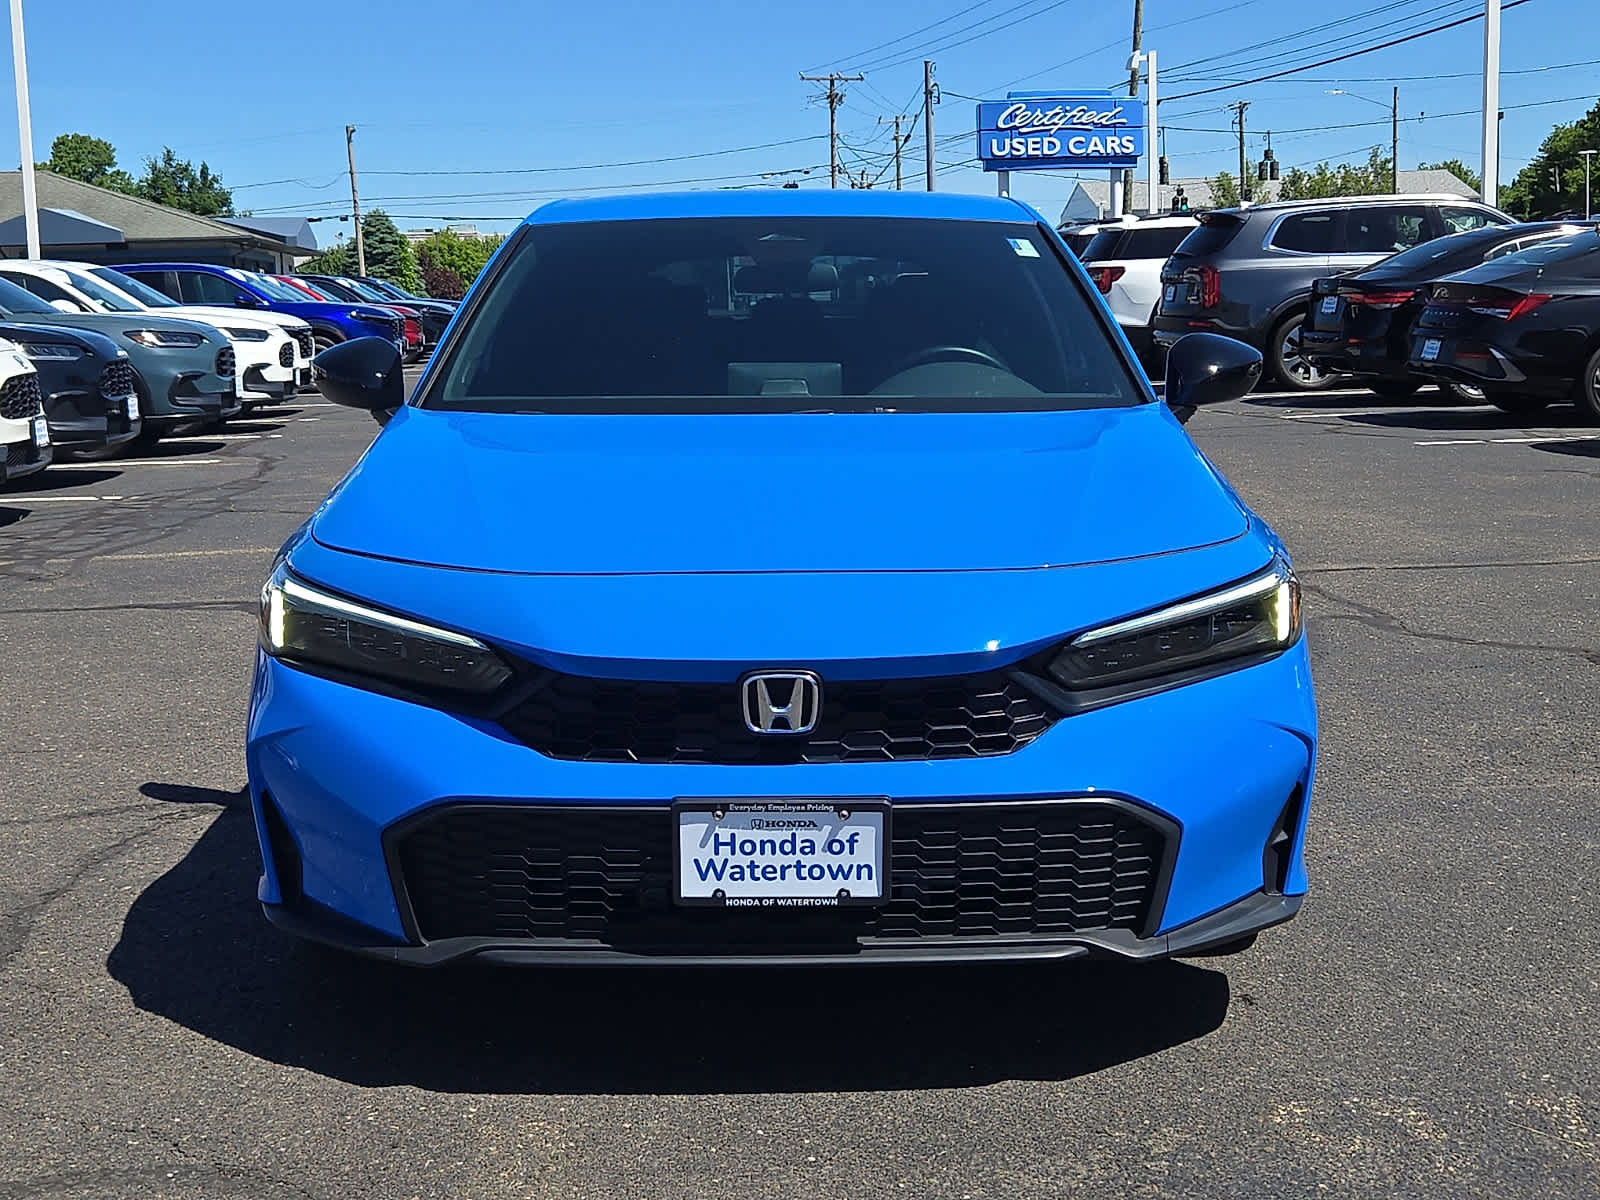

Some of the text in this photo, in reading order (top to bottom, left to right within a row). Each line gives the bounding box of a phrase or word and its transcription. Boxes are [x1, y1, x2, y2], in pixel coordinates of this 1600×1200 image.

[997, 103, 1128, 134] Certified
[991, 135, 1135, 156] USED CARS
[729, 804, 834, 812] Everyday Employee Pricing
[765, 820, 818, 828] HONDA
[713, 832, 860, 856] Honda of
[693, 858, 873, 881] Watertown
[725, 898, 838, 906] HONDA OF WATERTOWN
